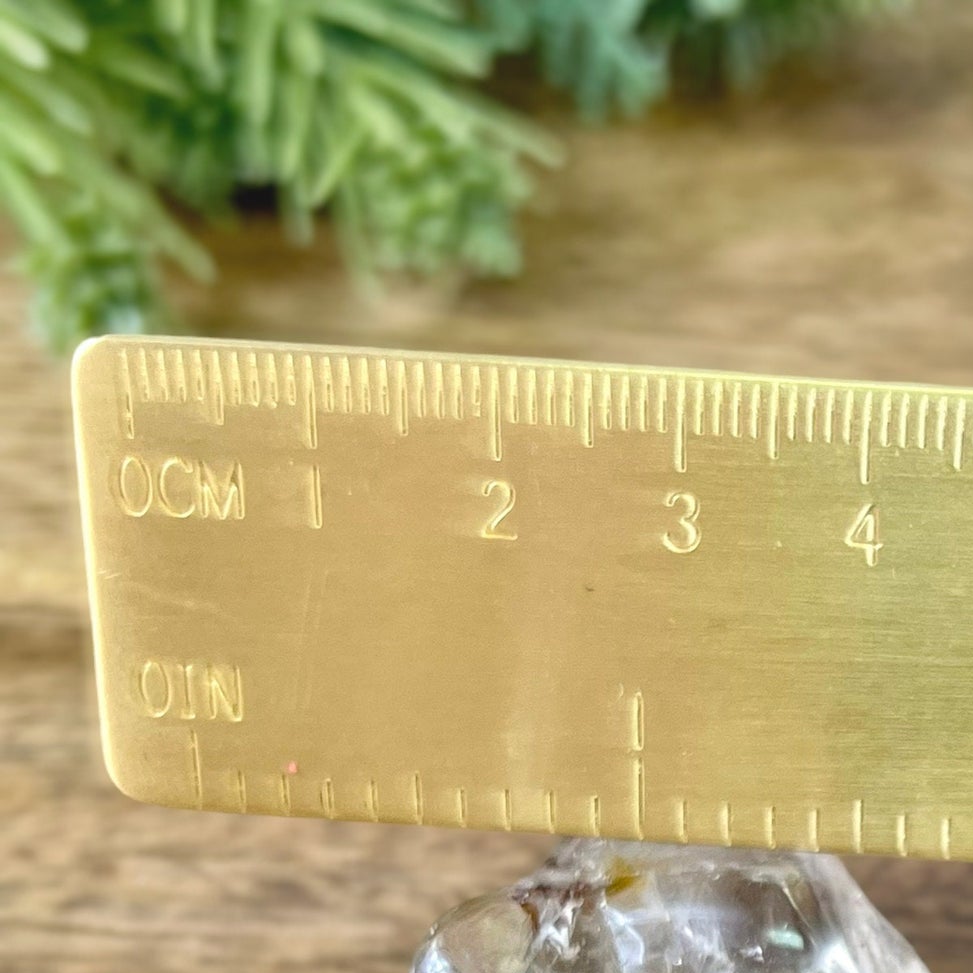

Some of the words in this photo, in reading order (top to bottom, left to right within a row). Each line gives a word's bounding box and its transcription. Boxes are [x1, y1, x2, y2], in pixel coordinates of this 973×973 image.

[308, 463, 324, 529] 1
[479, 480, 518, 541] 2
[661, 492, 701, 554] 3
[843, 503, 883, 566] 4
[631, 691, 645, 751] 1
